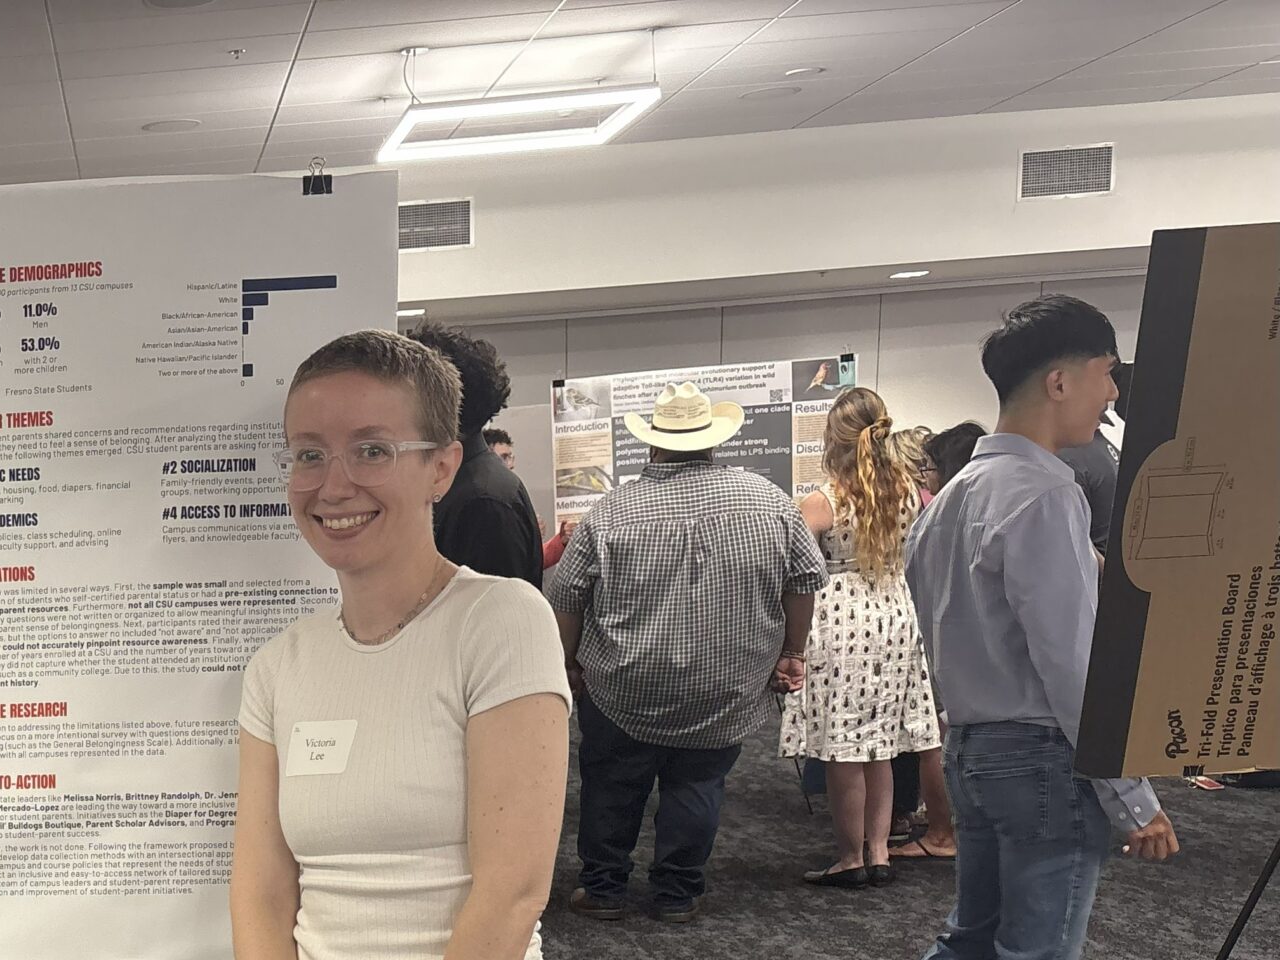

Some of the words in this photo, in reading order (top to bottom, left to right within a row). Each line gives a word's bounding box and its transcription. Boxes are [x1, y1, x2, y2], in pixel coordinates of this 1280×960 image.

[10, 261, 102, 283] DEMOGRAPHICS
[23, 302, 57, 318] 11.0%
[21, 337, 60, 352] 53.0%
[701, 367, 740, 376] evolutionary
[742, 365, 767, 373] support
[6, 387, 32, 396] Fresno
[34, 386, 55, 394] State
[57, 384, 92, 393] Students
[770, 405, 790, 413] clade
[795, 403, 832, 413] Results
[6, 411, 53, 429] THEMES
[555, 421, 609, 435] Introduction
[744, 438, 768, 447] strong
[715, 450, 738, 458] related
[749, 448, 763, 456] LPS
[765, 447, 790, 455] binding
[162, 461, 177, 474] #2
[180, 458, 256, 473] SOCIALIZATION
[9, 467, 40, 481] NEEDS
[162, 507, 177, 520] #4
[181, 505, 220, 519] ACCESS
[224, 505, 236, 518] TO
[240, 503, 292, 518] INFORMAT
[1265, 575, 1280, 607] trois
[1236, 566, 1263, 670] presentaciones
[1261, 611, 1275, 619] à
[1197, 709, 1217, 759] Tri-Fold
[1207, 619, 1233, 706] Presentation
[1222, 574, 1241, 615] Board
[1248, 623, 1276, 696] d'affichage
[1230, 675, 1243, 704] para
[10, 702, 67, 718] RESEARCH
[1165, 709, 1189, 759] Pacon
[1237, 700, 1259, 756] Panneau
[305, 737, 336, 747] Victoria
[310, 751, 325, 760] Lee
[63, 794, 94, 802] Melissa
[96, 793, 123, 801] Norris,
